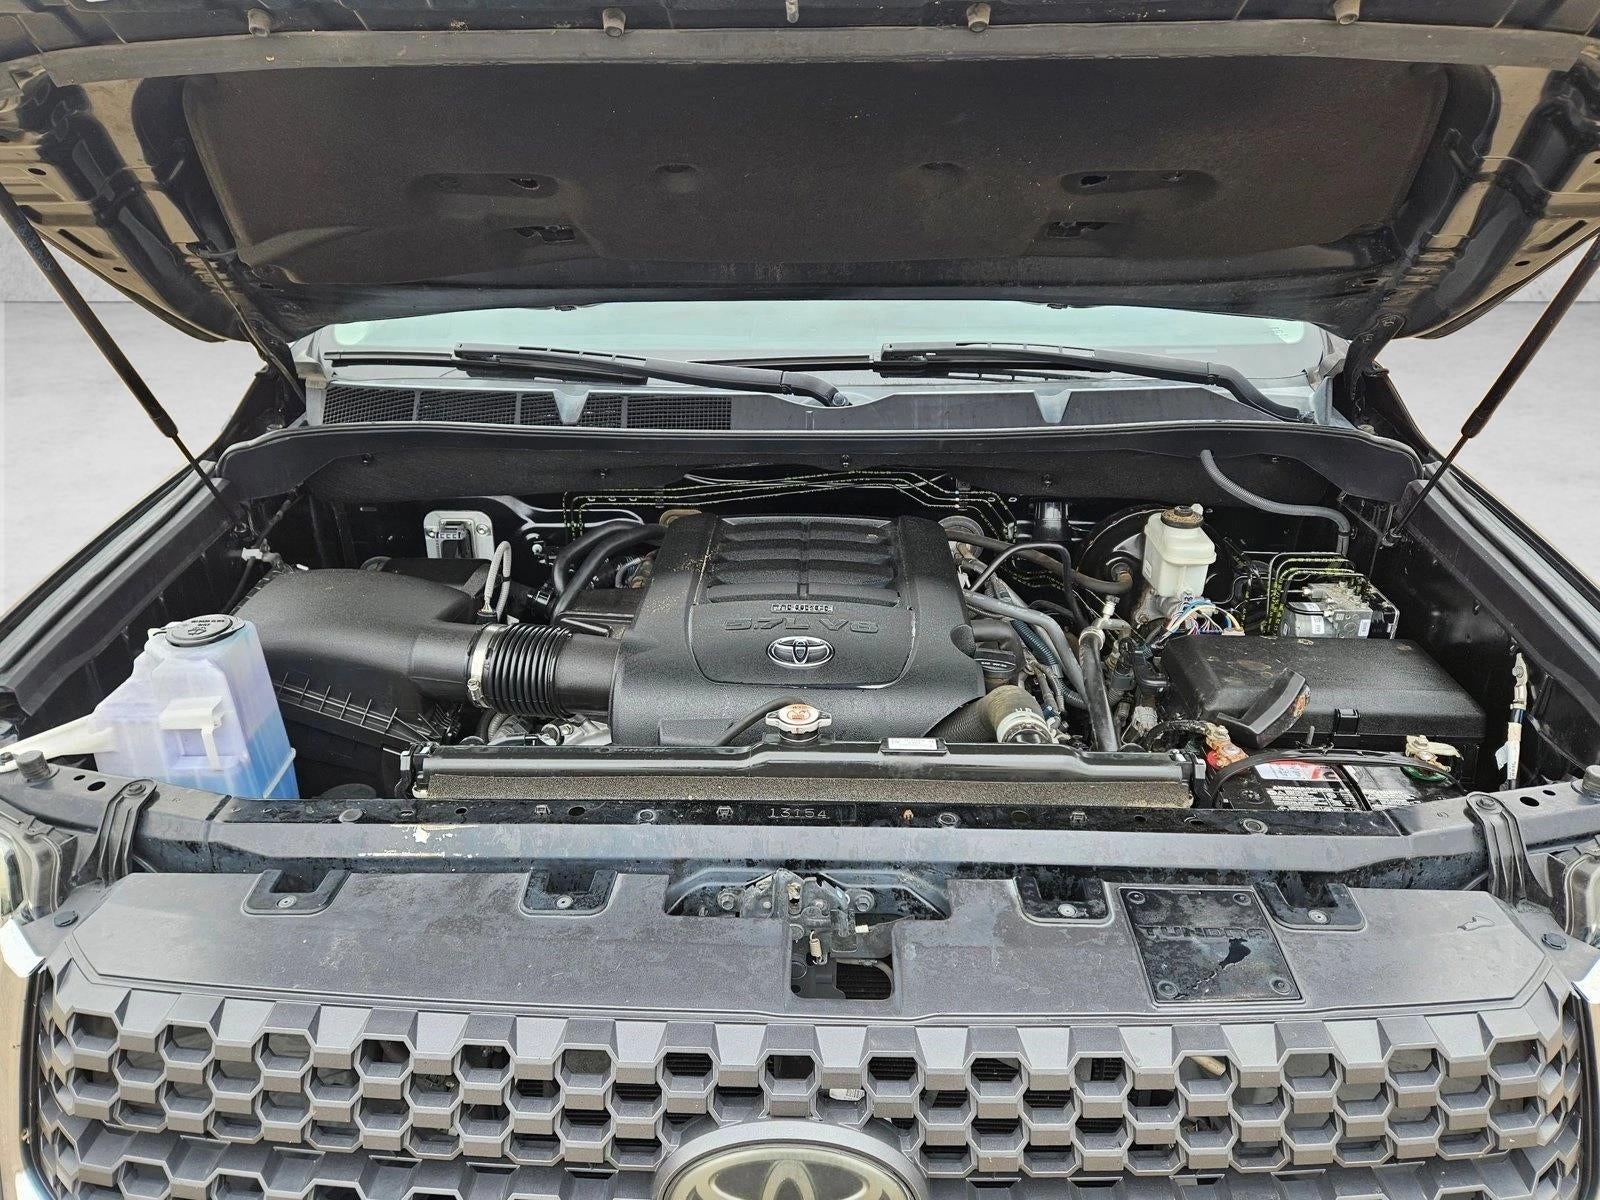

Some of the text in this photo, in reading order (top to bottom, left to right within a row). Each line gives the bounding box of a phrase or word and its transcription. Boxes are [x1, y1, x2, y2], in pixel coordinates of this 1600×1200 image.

[725, 617, 879, 633] 5.7L V8
[768, 807, 828, 819] 13154
[1138, 925, 1270, 940] TUNDRA
